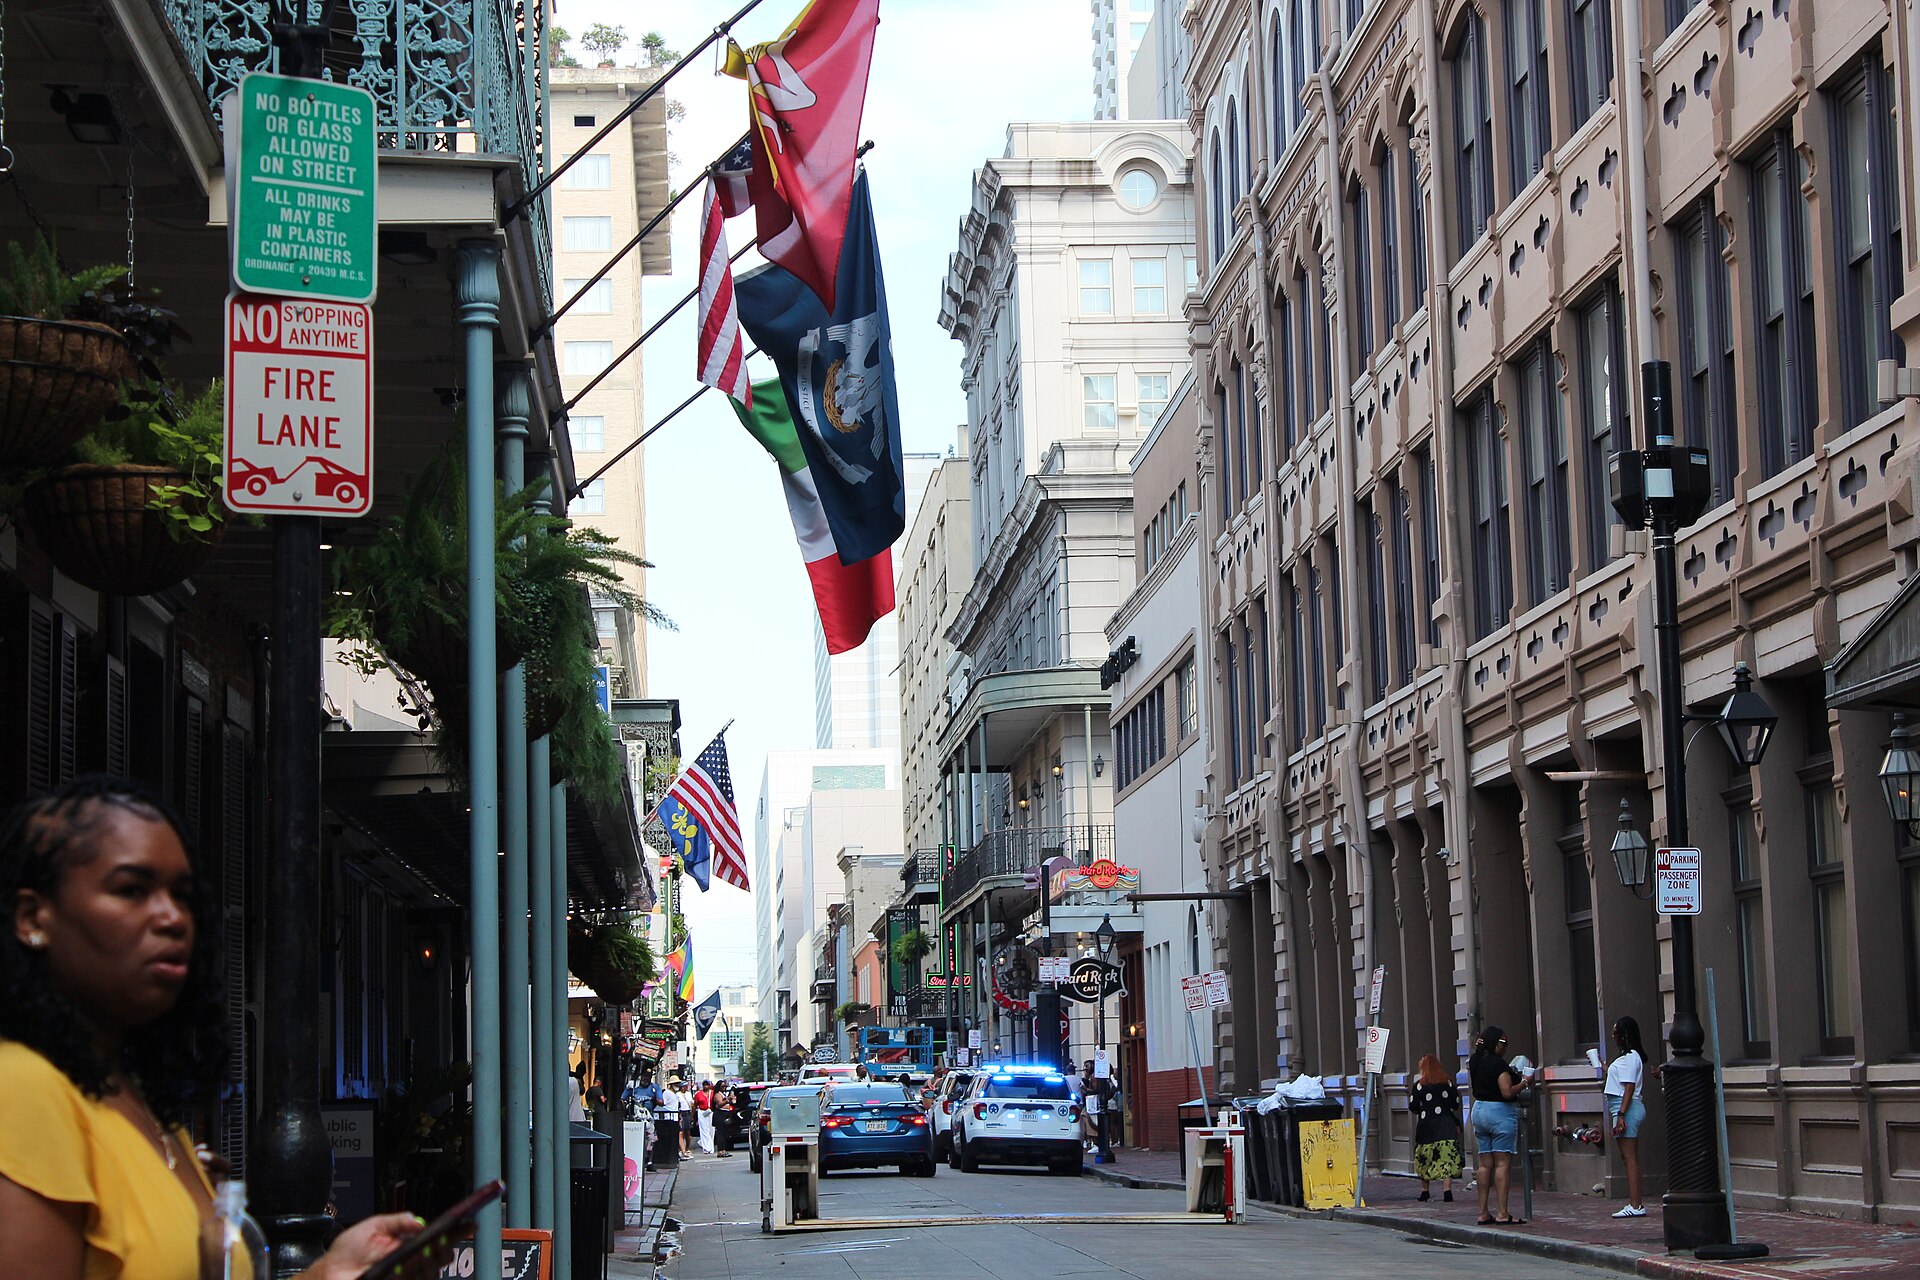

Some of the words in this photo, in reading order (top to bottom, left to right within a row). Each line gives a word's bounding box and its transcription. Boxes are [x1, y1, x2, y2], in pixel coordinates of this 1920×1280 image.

[256, 93, 280, 112] NO
[288, 97, 361, 125] BOTTLES
[266, 114, 288, 134] OR
[297, 119, 352, 144] GLASS
[269, 136, 349, 163] ALLOWED
[260, 155, 284, 175] ON
[292, 160, 357, 185] STREET
[265, 188, 291, 205] ALL
[297, 192, 351, 213] DRINKS
[280, 208, 312, 225] MAY
[317, 212, 335, 229] BE
[267, 223, 282, 240] IN
[289, 227, 347, 247] PLASTIC
[261, 240, 352, 266] CONTAINERS
[245, 257, 295, 274] ORDINANCE
[308, 265, 337, 278] 20439
[339, 269, 366, 282] M.C.S.
[233, 303, 279, 344] NO
[283, 305, 364, 328] STOPPING
[289, 328, 359, 349] ANYTIME
[264, 366, 336, 403] FIRE
[801, 377, 811, 410] JUSTICE
[257, 412, 341, 449] LANE
[1079, 864, 1101, 876] Hard
[1658, 853, 1669, 865] NO
[1671, 855, 1697, 864] PARKING
[1660, 872, 1697, 880] PASSENGER
[1668, 881, 1690, 889] ZONE
[929, 976, 947, 986] Sinc
[327, 1119, 357, 1131] blic
[332, 1136, 360, 1151] king
